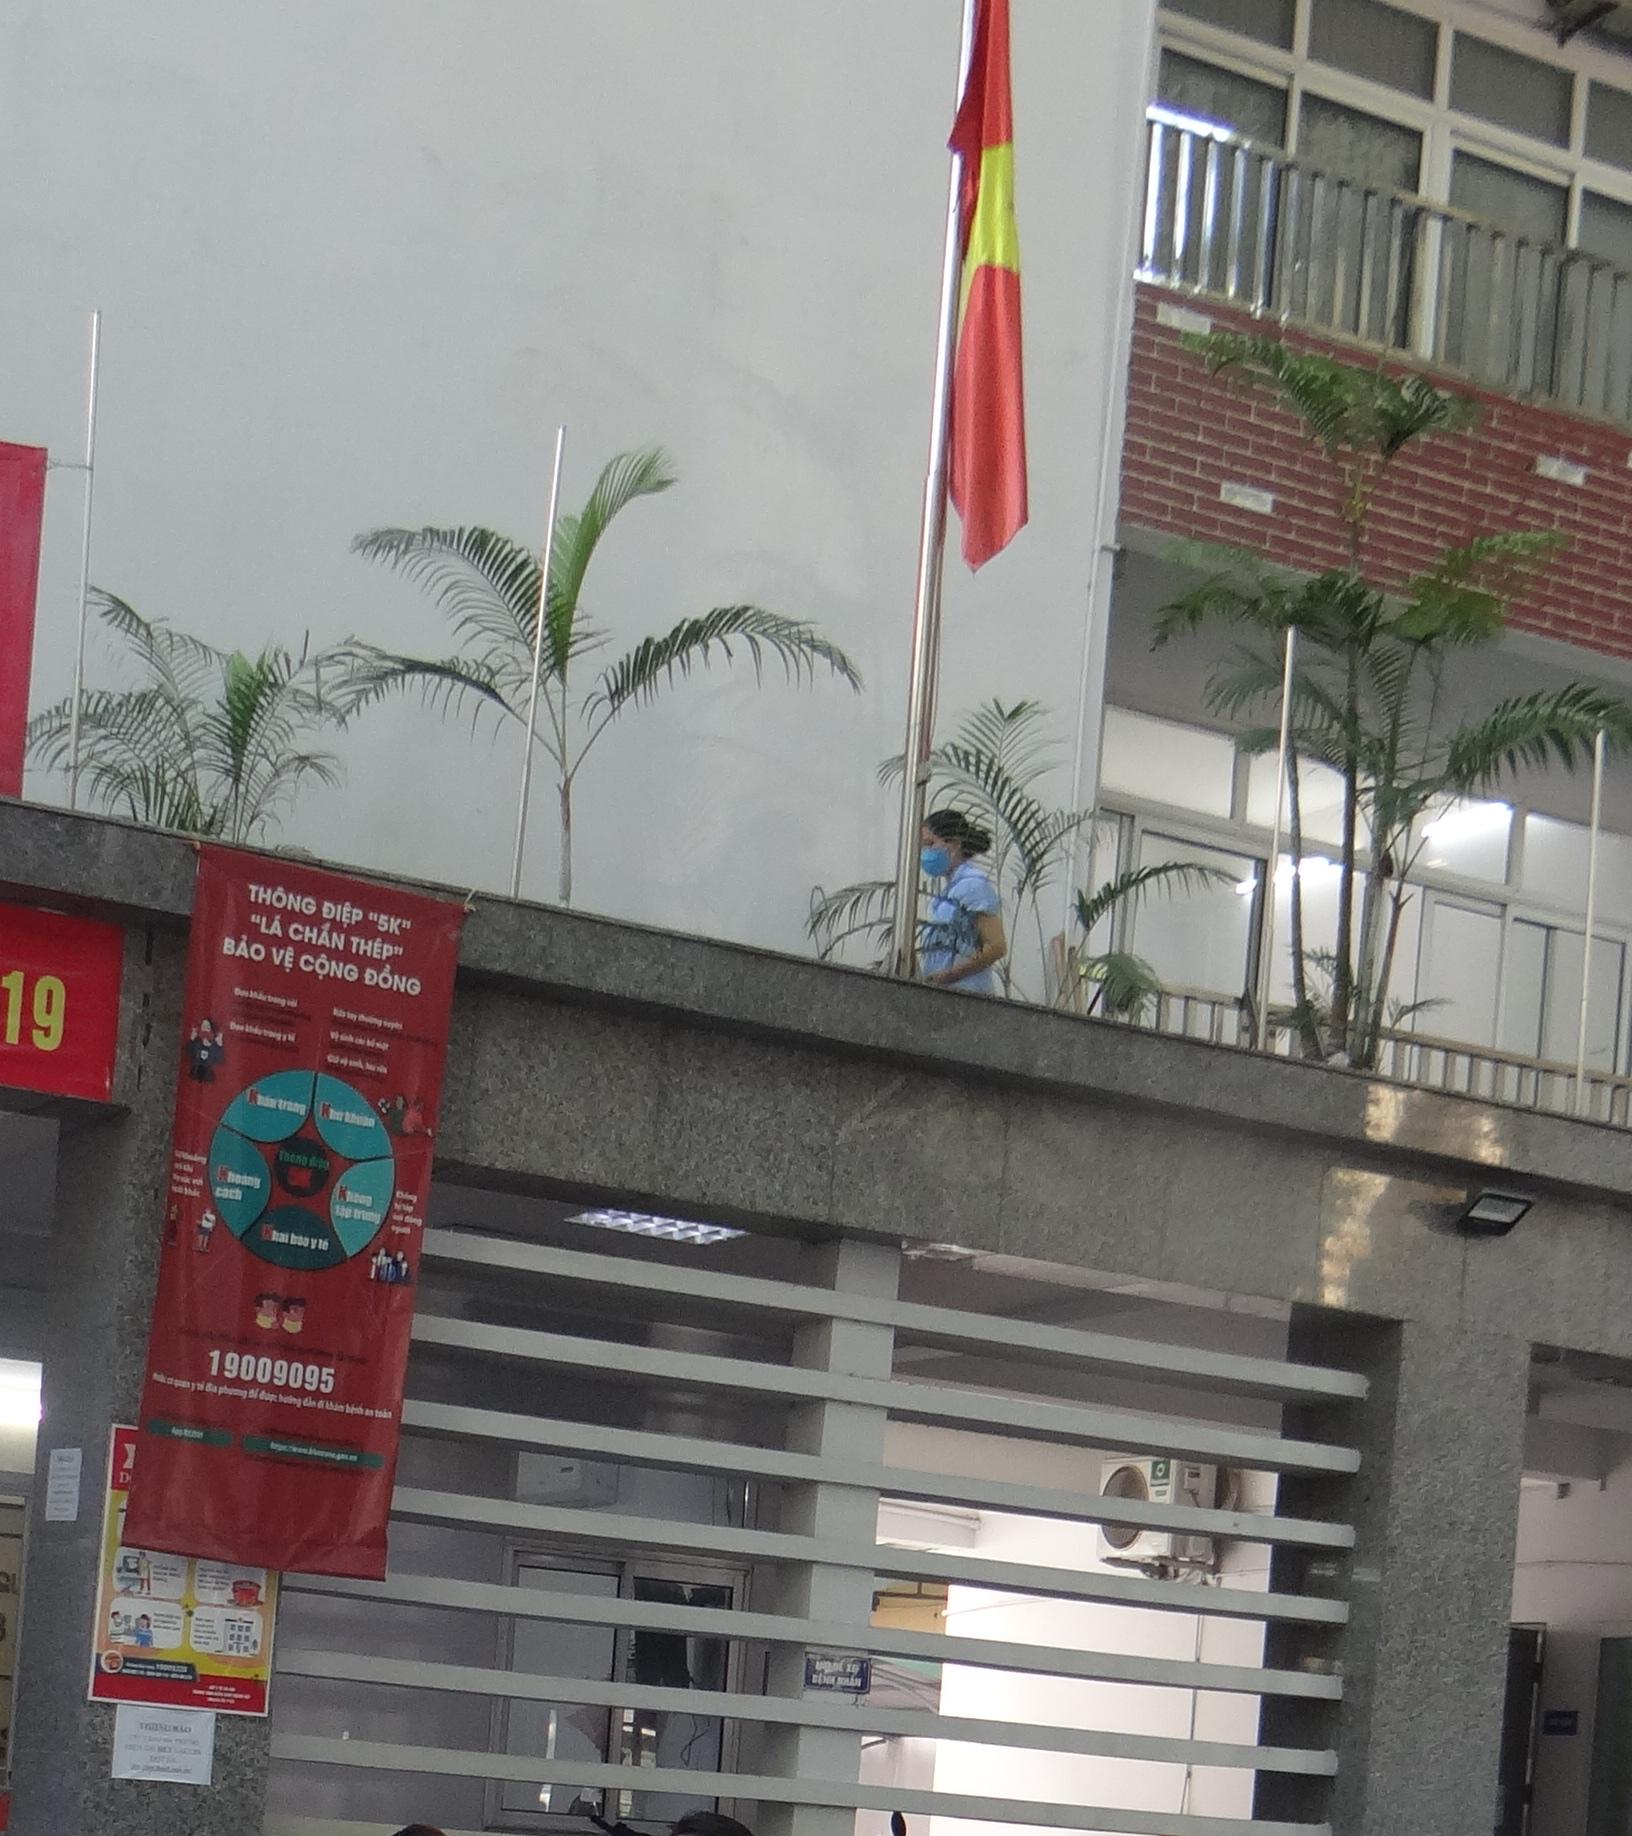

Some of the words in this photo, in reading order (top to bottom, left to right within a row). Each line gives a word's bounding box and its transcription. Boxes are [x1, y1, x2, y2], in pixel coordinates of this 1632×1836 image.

[248, 884, 317, 915] THÔNG
[322, 901, 363, 928] ĐIỆP
[288, 922, 345, 950] CHẮN
[223, 935, 265, 961] BẢO
[272, 947, 294, 973] VỆ
[299, 953, 358, 981] CỘNG
[364, 964, 421, 995] ĐỒNG
[208, 1350, 336, 1394] 19009095
